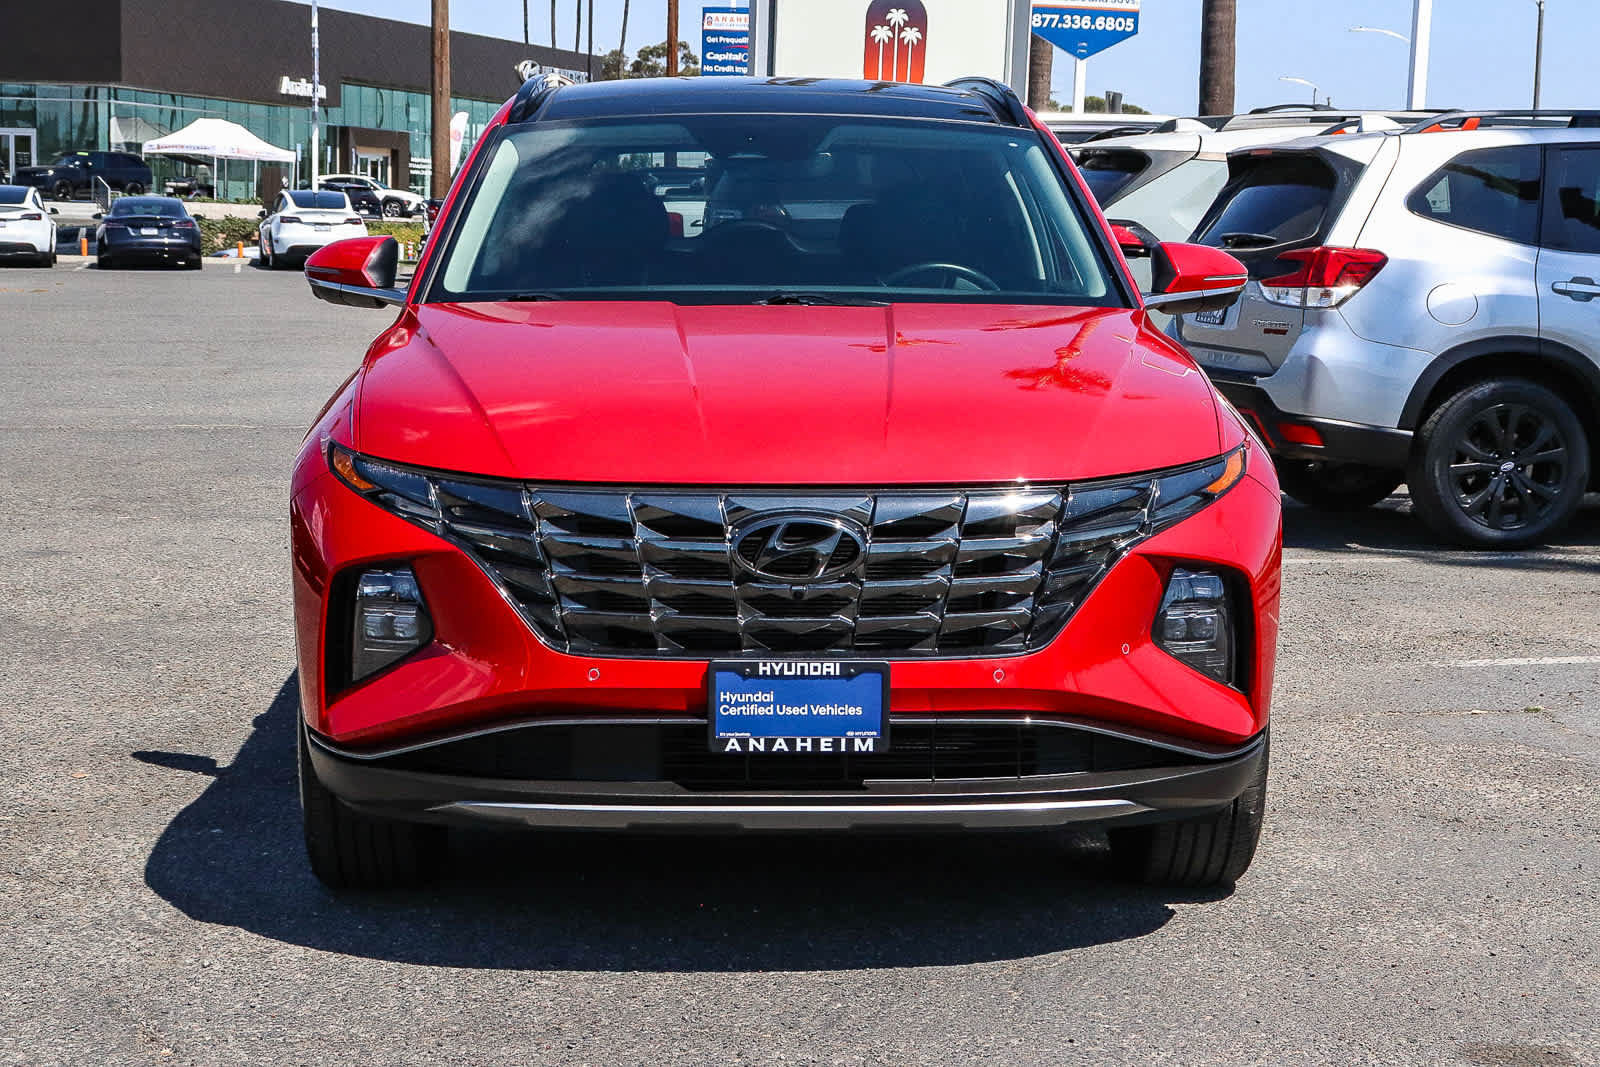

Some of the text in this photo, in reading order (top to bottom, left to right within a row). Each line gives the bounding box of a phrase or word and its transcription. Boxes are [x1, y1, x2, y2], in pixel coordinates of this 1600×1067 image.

[1032, 13, 1135, 32] 877.336.6805
[703, 64, 713, 72] No
[714, 65, 735, 73] Credit
[759, 662, 840, 675] HYUNDAI
[720, 691, 774, 704] Hyundai
[720, 704, 863, 716] Certified Used Vehicles
[725, 737, 874, 752] ANAHEIM
